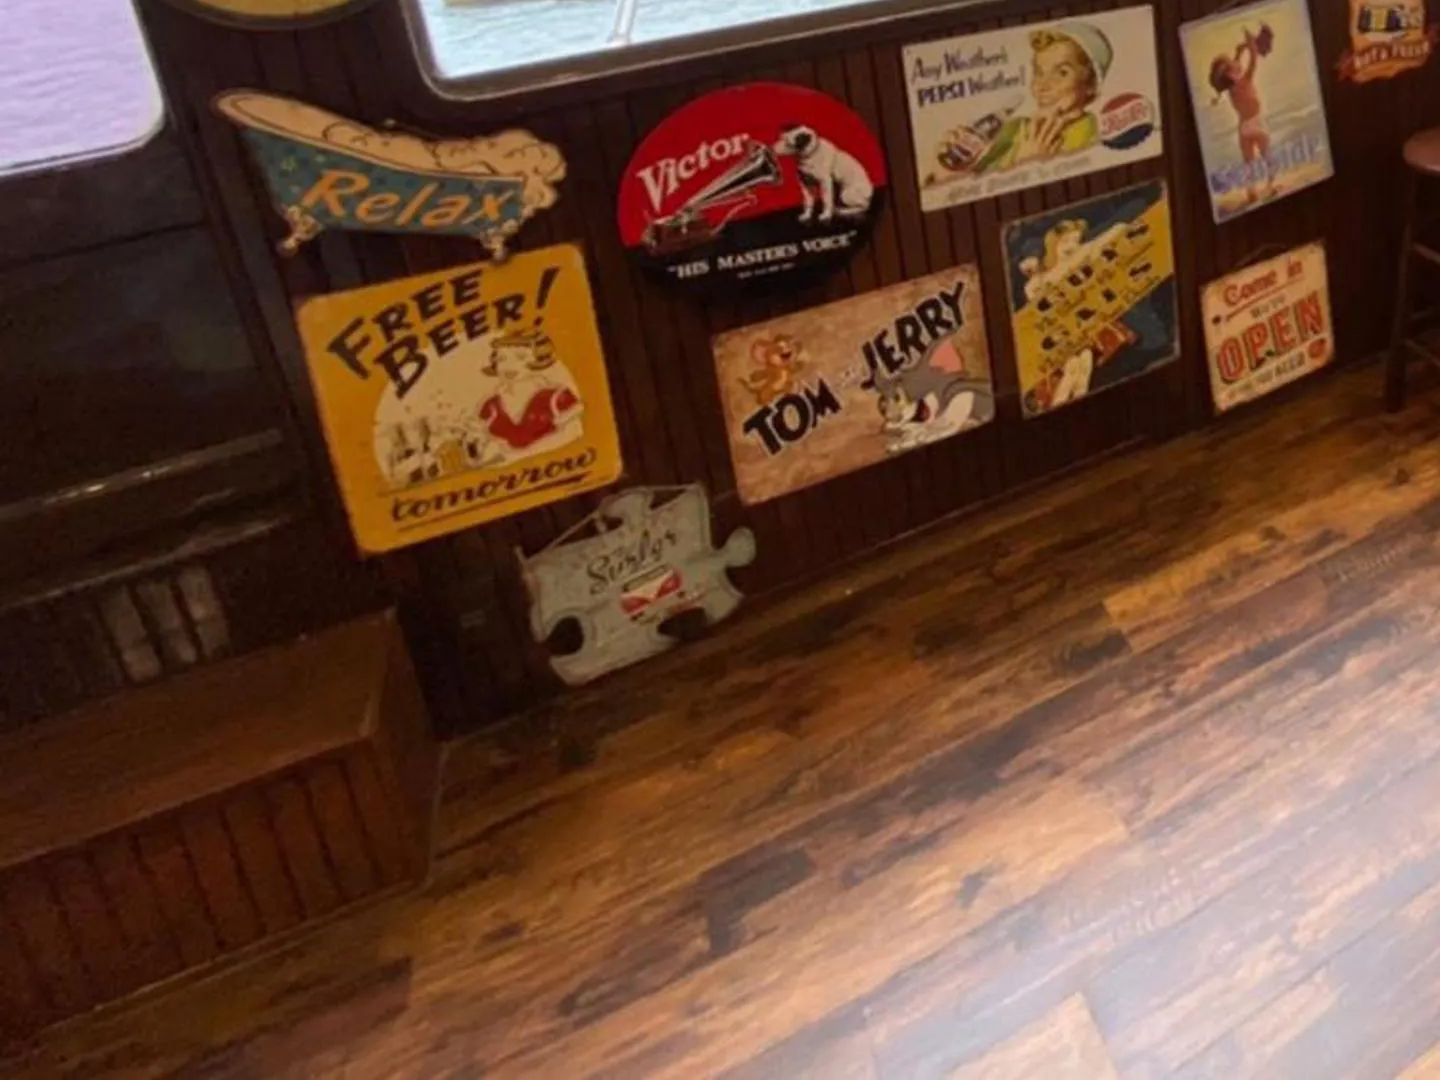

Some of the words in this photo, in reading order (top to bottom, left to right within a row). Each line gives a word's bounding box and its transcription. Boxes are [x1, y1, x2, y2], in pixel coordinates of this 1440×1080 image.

[918, 80, 965, 108] PEPSI
[300, 170, 513, 226] Relax
[637, 133, 749, 213] Victor
[327, 270, 484, 380] FREE
[860, 281, 966, 390] JERRY
[1217, 290, 1325, 384] OPEN
[744, 378, 843, 456] TOM
